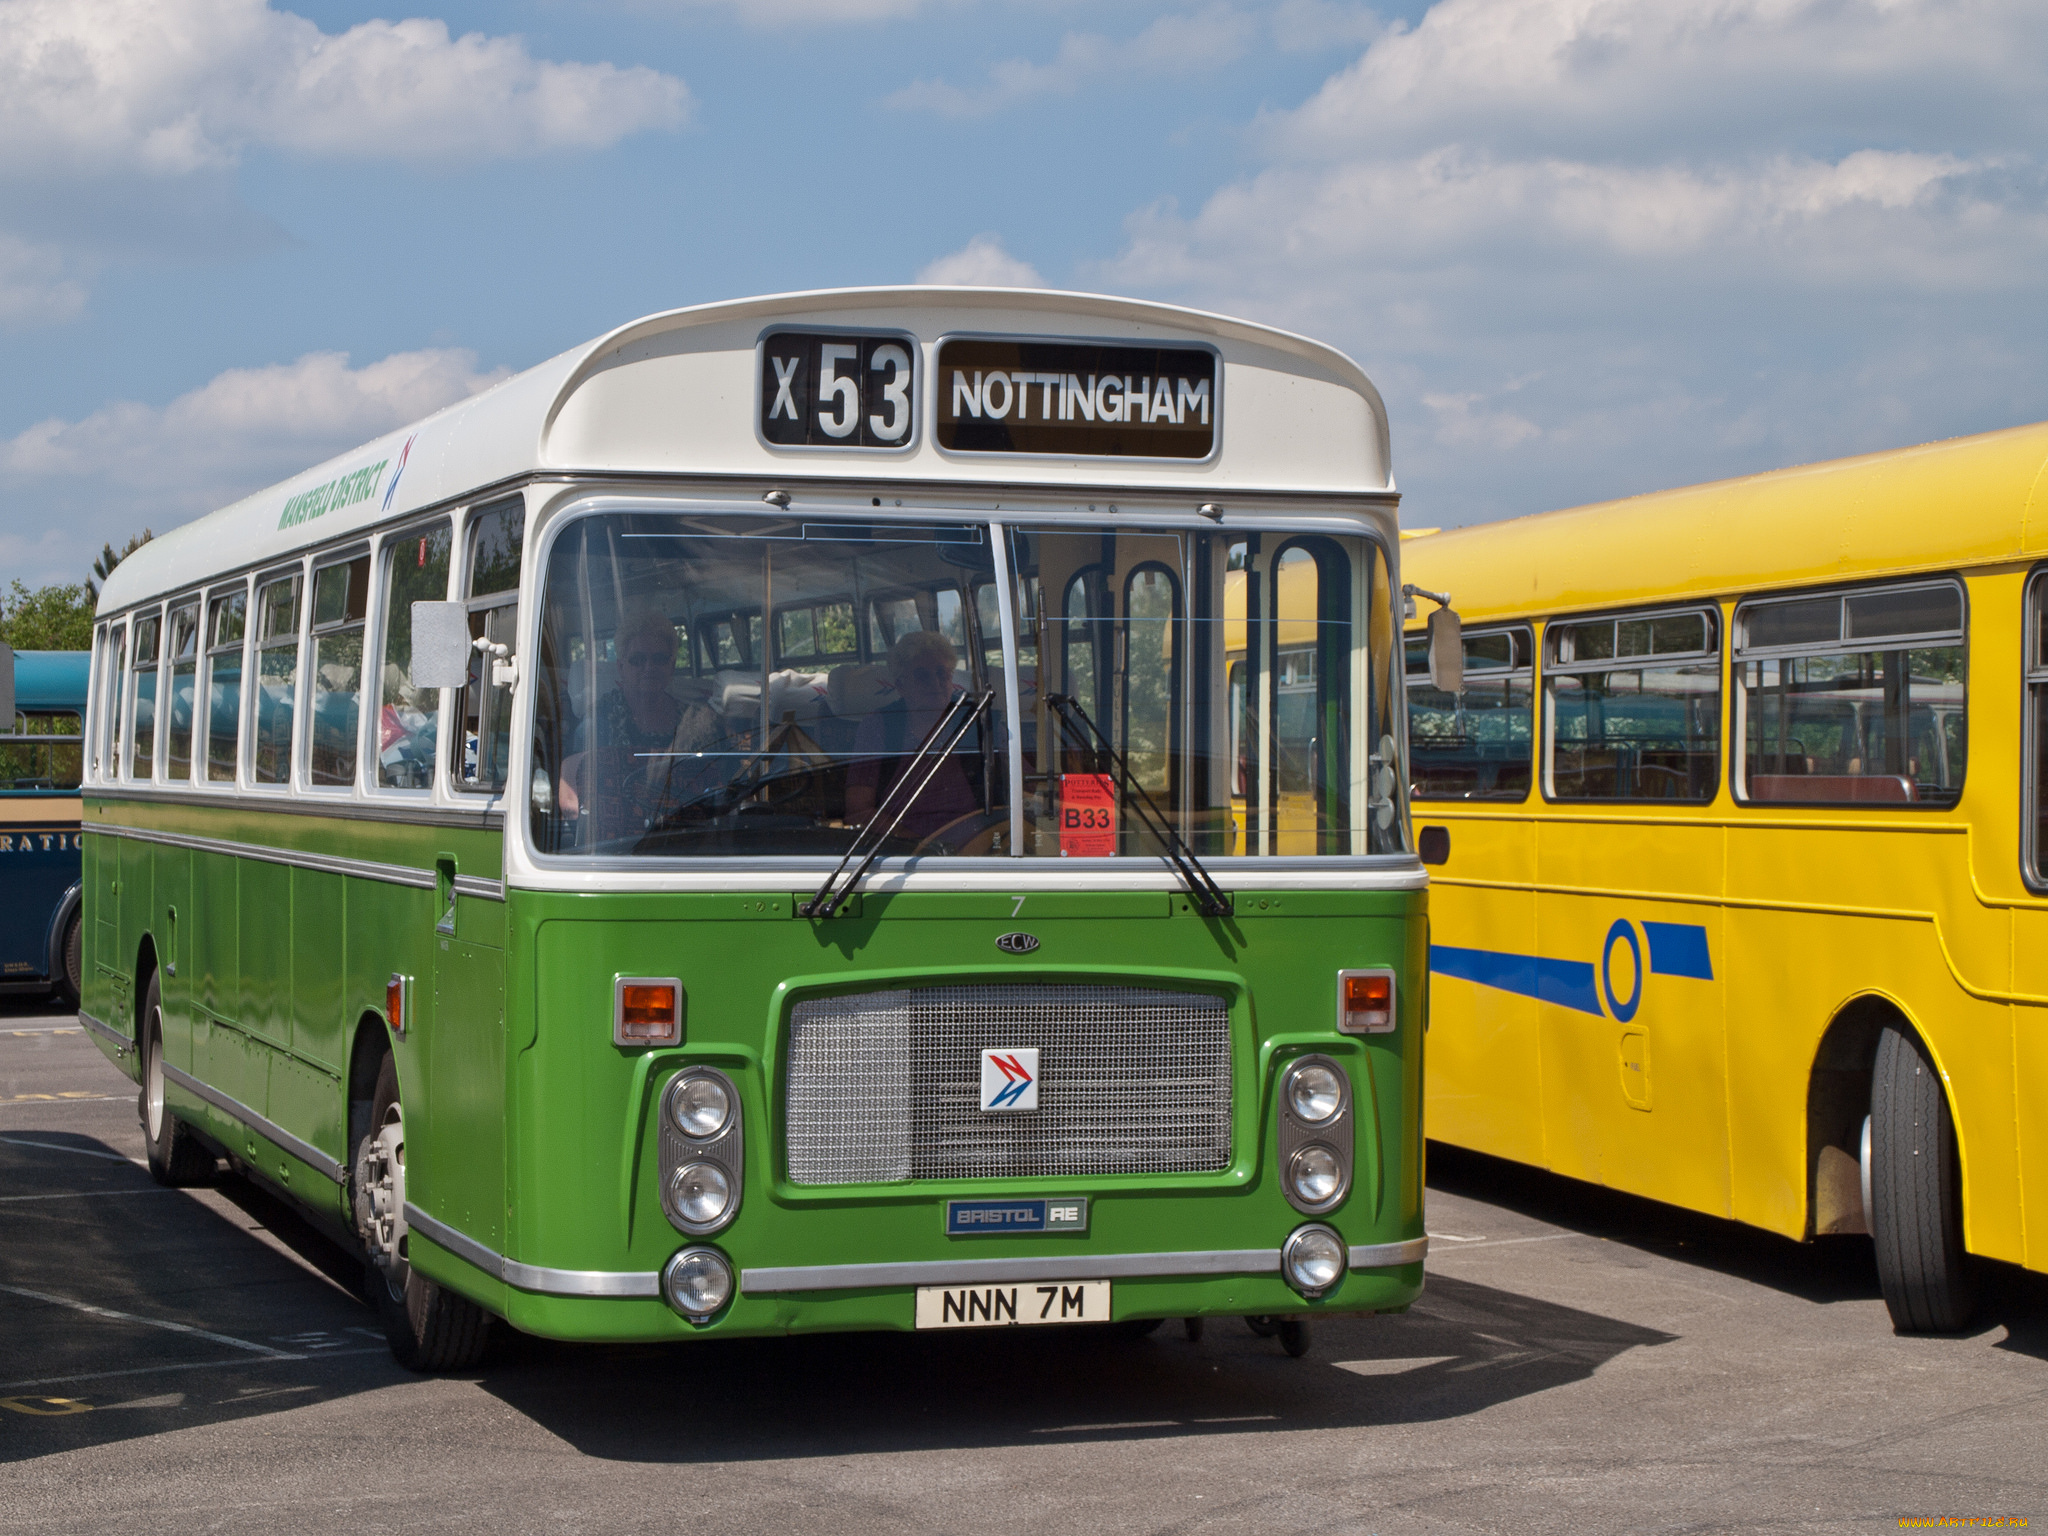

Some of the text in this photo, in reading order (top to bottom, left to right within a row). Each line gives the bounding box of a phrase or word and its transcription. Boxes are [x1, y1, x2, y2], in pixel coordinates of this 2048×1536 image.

[952, 370, 1210, 425] NOTTINGHAM
[277, 458, 390, 532] MANSFIELD DISTRICT
[1064, 808, 1111, 829] B33
[1010, 895, 1026, 918] 7
[1000, 933, 1036, 951] ECW
[956, 1208, 1040, 1224] BRISTOL
[942, 1285, 1085, 1323] NNN 7M
